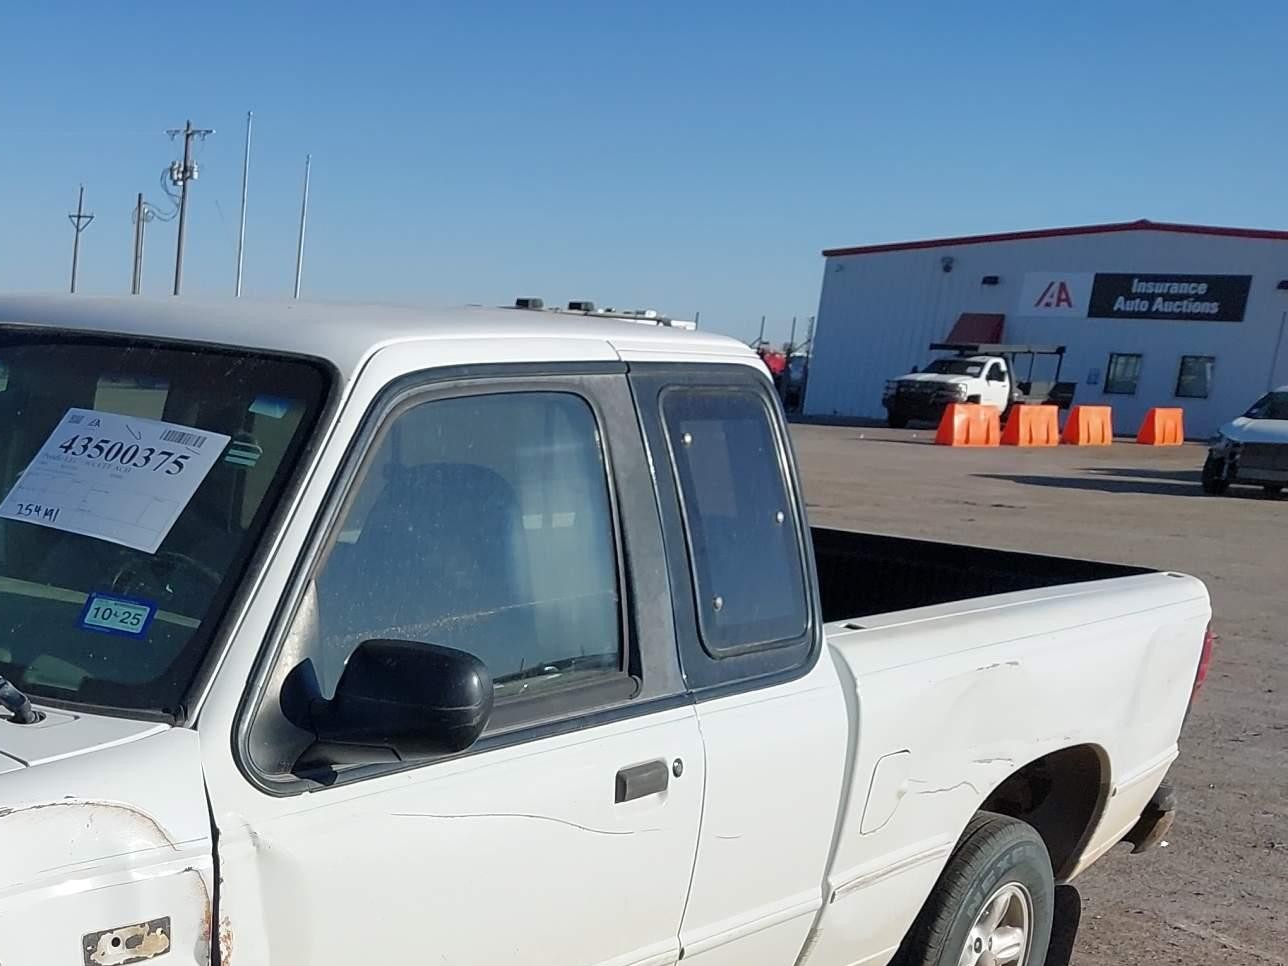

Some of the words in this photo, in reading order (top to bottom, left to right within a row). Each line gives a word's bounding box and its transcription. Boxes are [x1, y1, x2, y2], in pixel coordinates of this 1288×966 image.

[1131, 278, 1208, 295] Insurance
[1113, 296, 1149, 312] Auto
[1152, 297, 1219, 315] Auctions
[58, 434, 192, 476] 43500375
[93, 606, 113, 621] 10
[119, 610, 143, 626] 25
